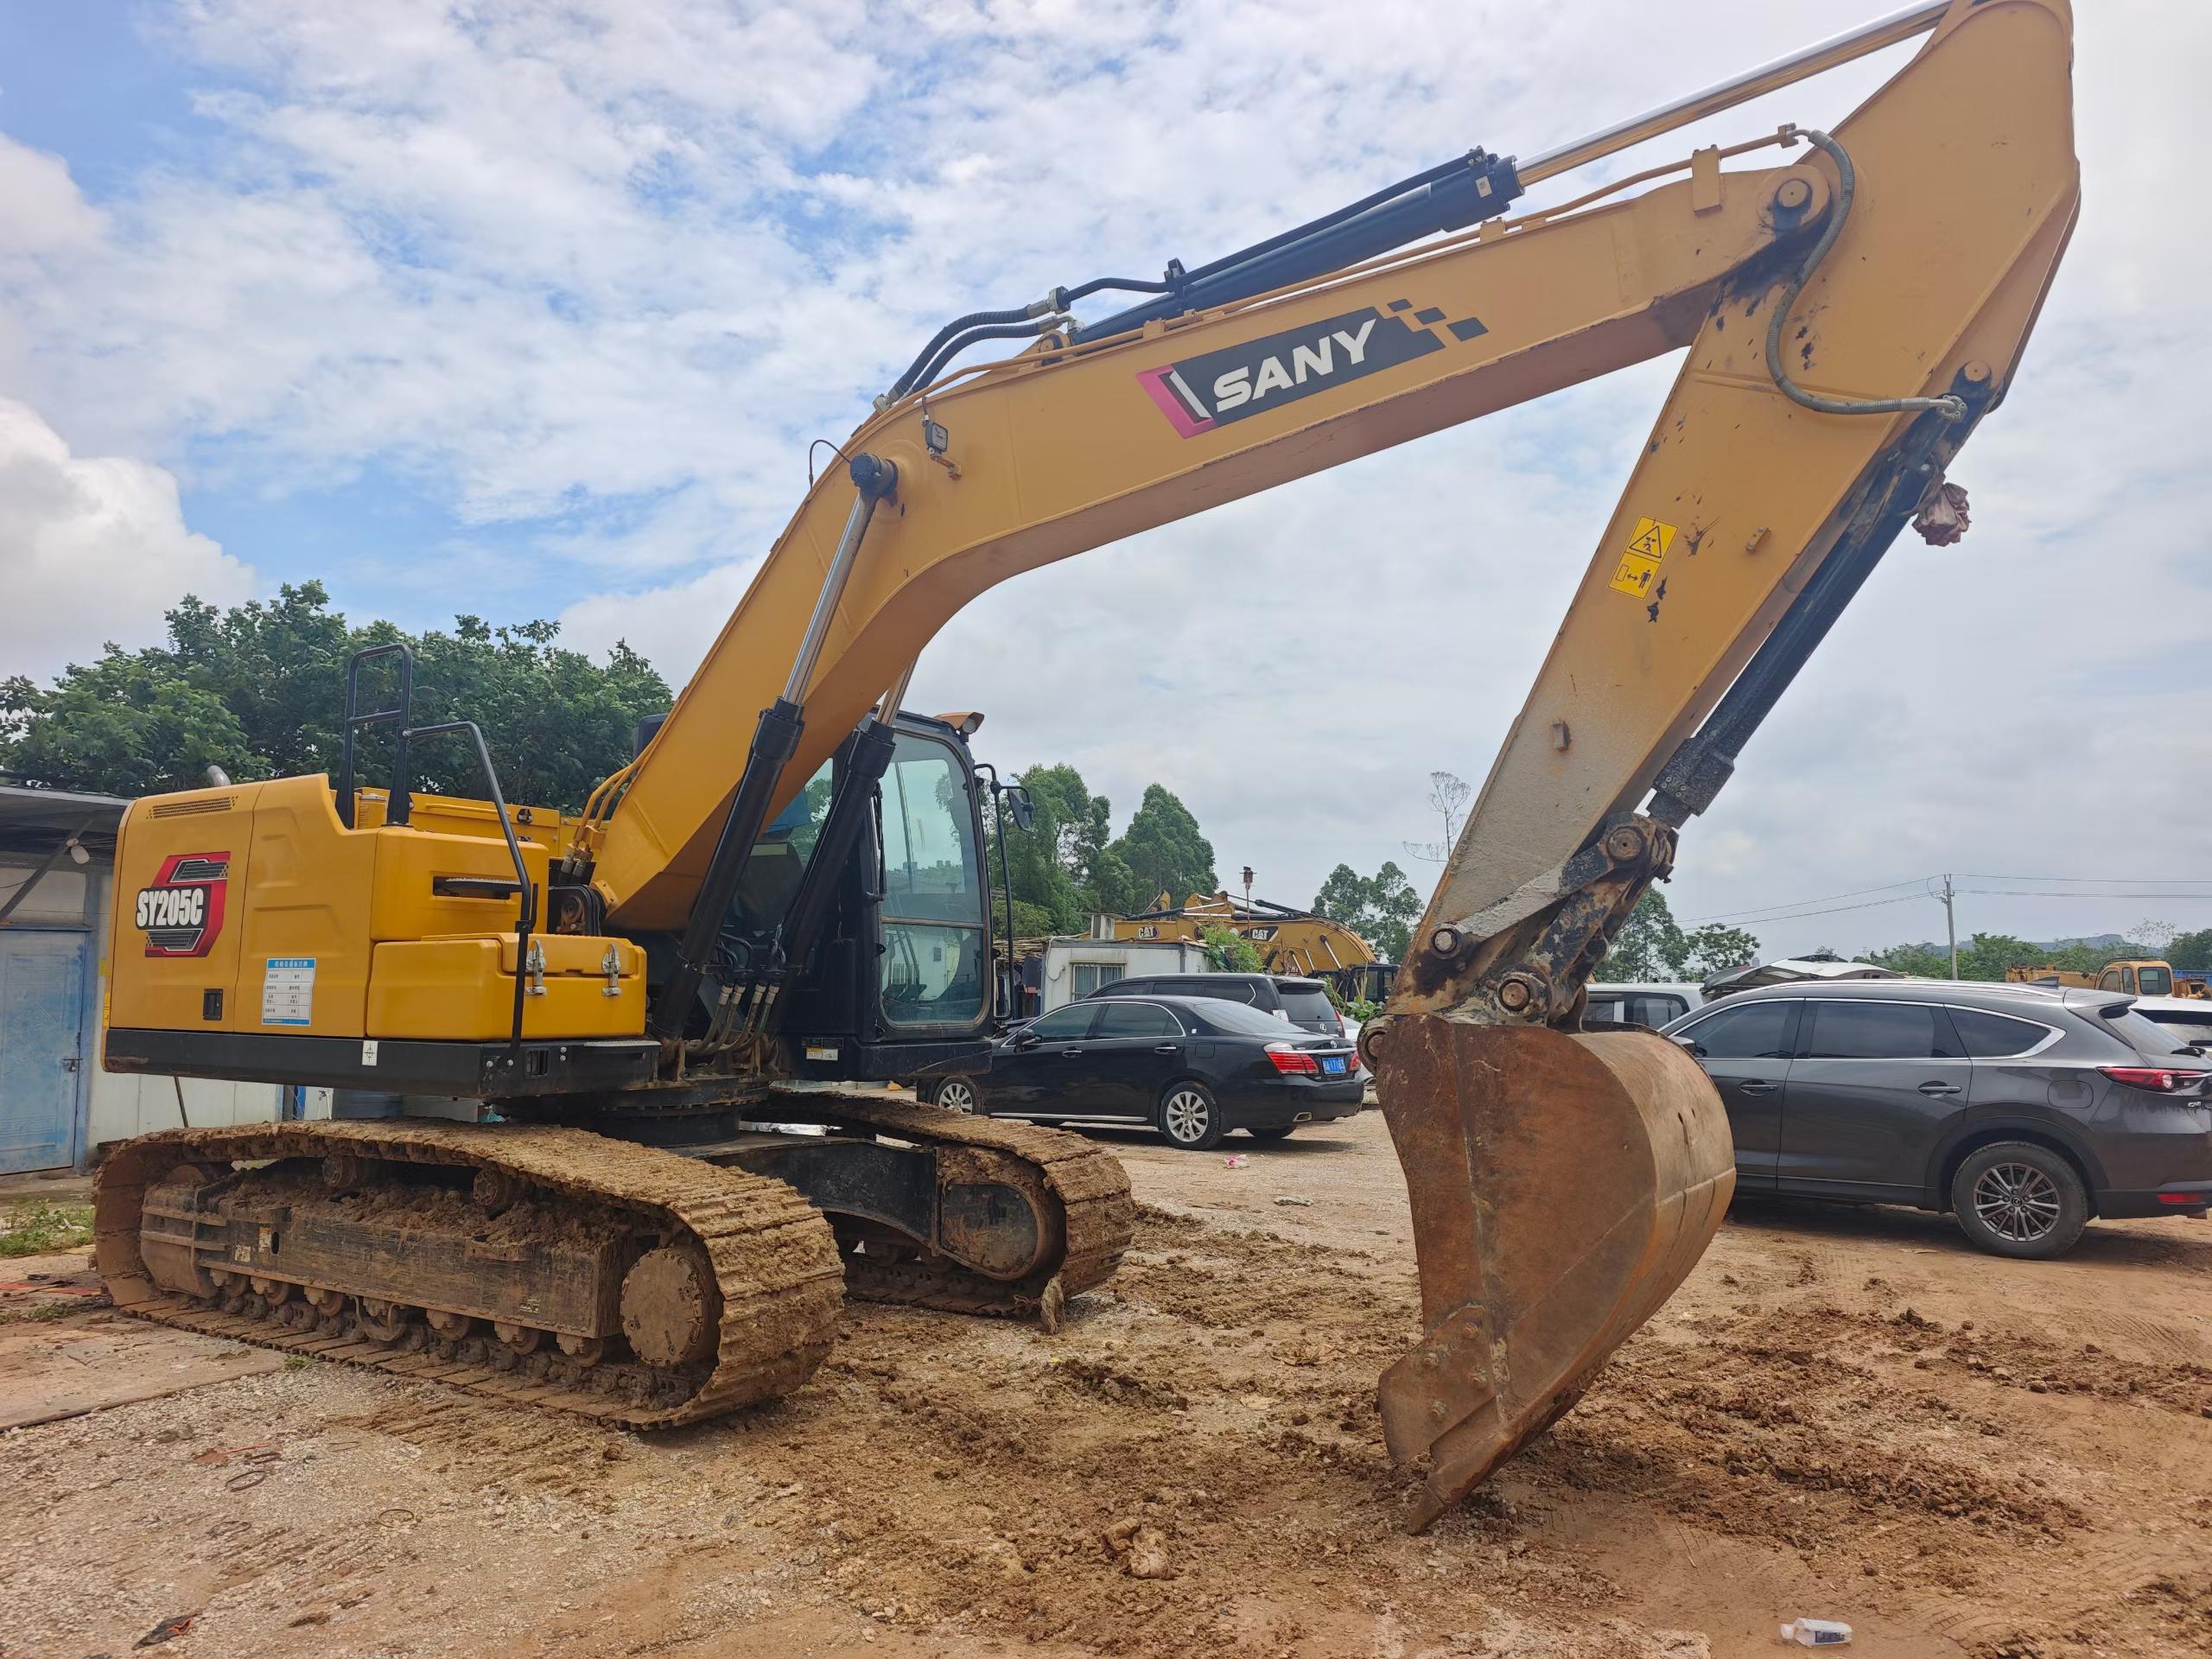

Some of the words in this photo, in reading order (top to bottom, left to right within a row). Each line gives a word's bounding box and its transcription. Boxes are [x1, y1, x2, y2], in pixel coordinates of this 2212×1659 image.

[1213, 318, 1376, 412] SANY
[137, 888, 204, 927] SY205C
[1138, 927, 1154, 938] CAT
[1252, 930, 1268, 940] CAT
